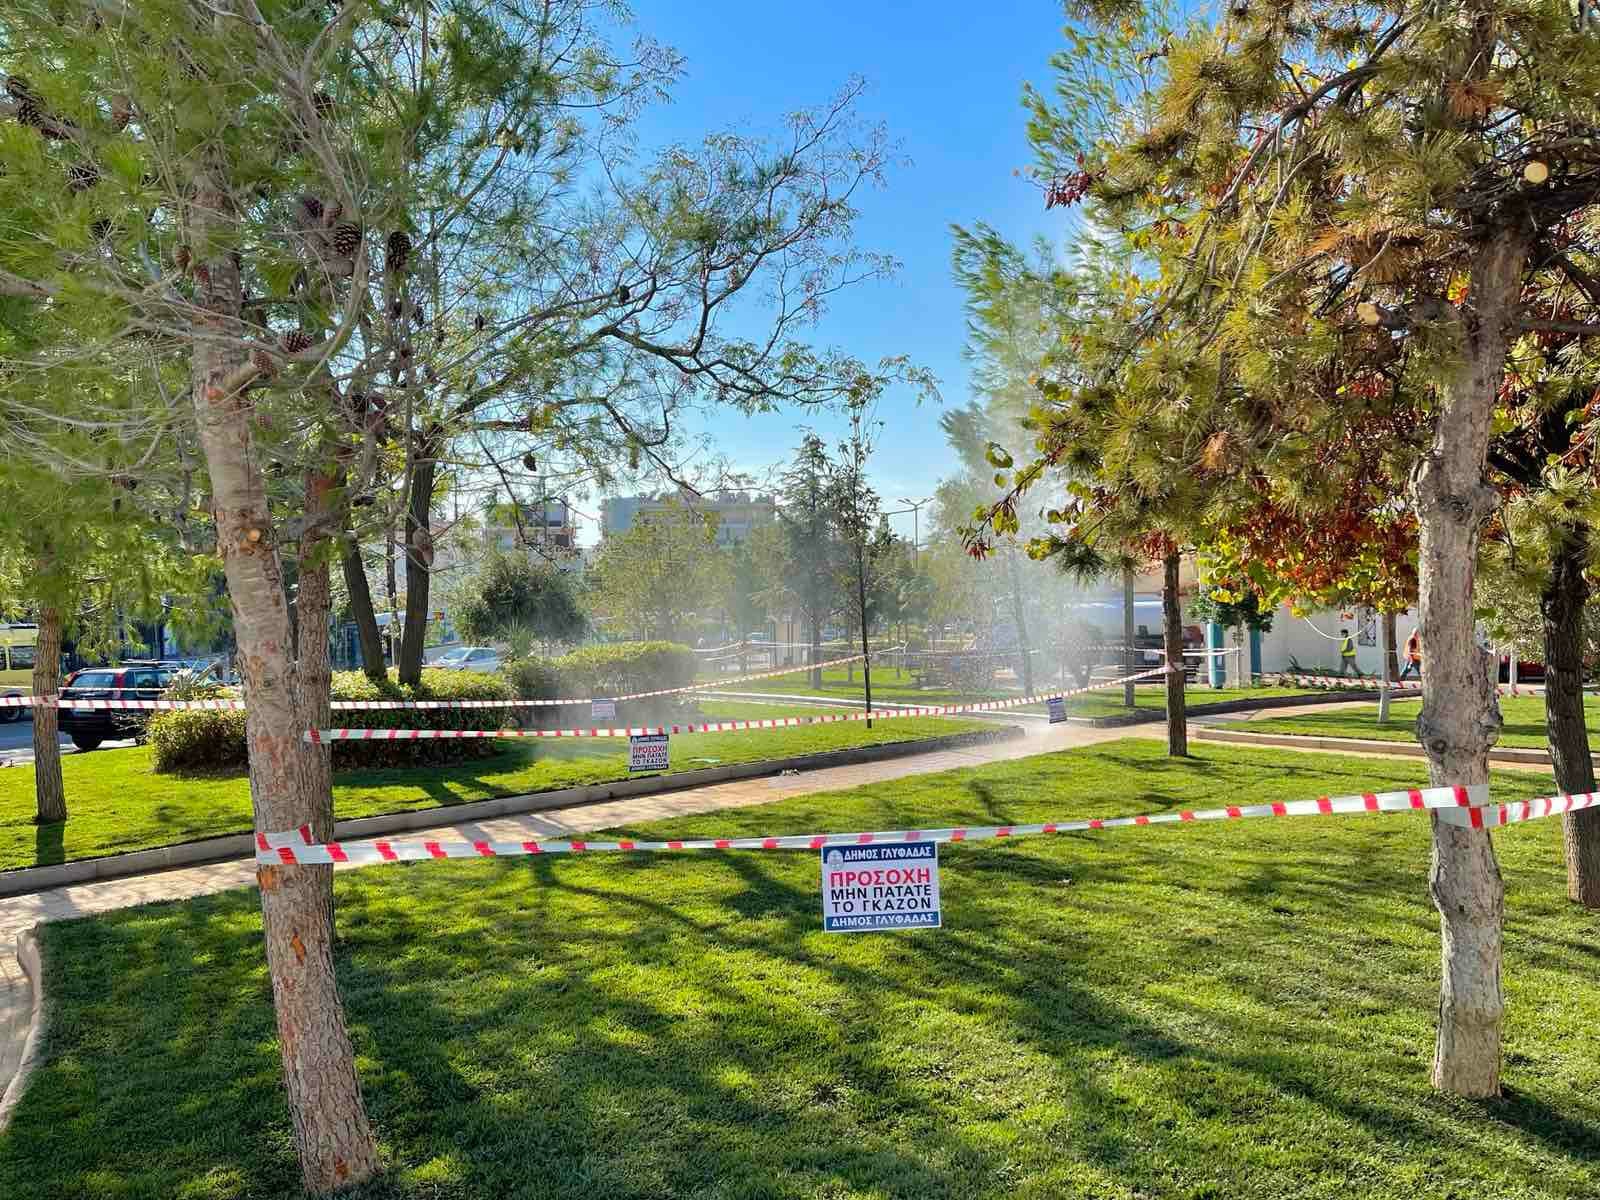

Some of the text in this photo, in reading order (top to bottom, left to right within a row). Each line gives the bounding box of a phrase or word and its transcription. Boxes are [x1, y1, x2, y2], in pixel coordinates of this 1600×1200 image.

[844, 846, 932, 861] ΔΗΜΟΣ ΓΛΥΦΑΔΑΣ
[830, 867, 930, 887] ΠΡΟΣΟΧΗ
[831, 884, 932, 901] ΜΗΝ ΠΑΤΑΤΕ
[832, 897, 931, 913] ΤΟ ΓΚΑΖΟΝ
[831, 913, 934, 927] ΔΗΜΟΣ ΓΛΥΦΑΔΑΣ
